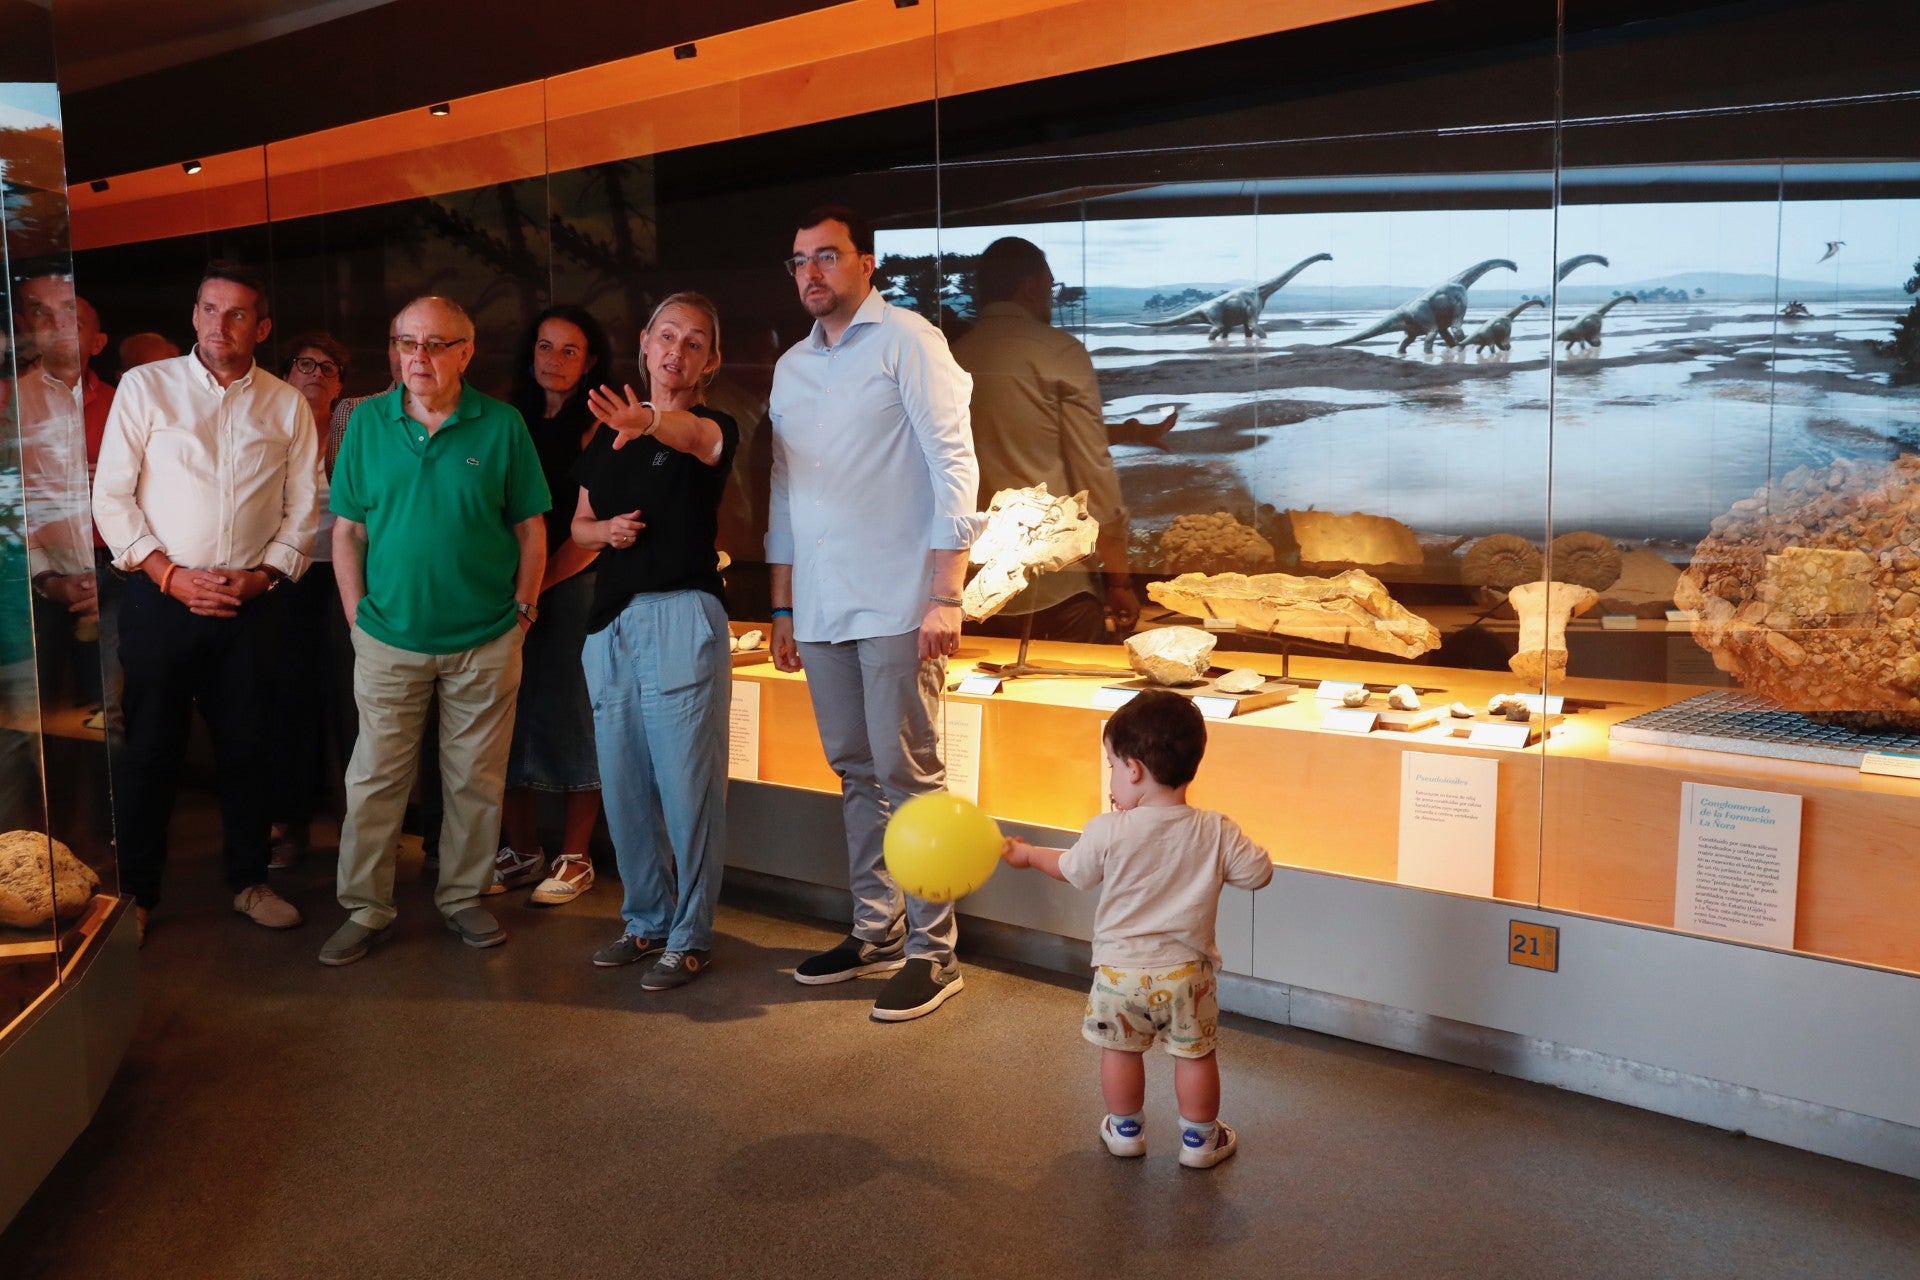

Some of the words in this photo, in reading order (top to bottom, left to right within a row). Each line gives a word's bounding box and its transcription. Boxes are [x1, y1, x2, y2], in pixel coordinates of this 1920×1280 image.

[1700, 799, 1770, 814] Conglomerado
[1700, 808, 1711, 816] de
[1725, 812, 1776, 824] Formación
[1513, 934, 1540, 957] 21
